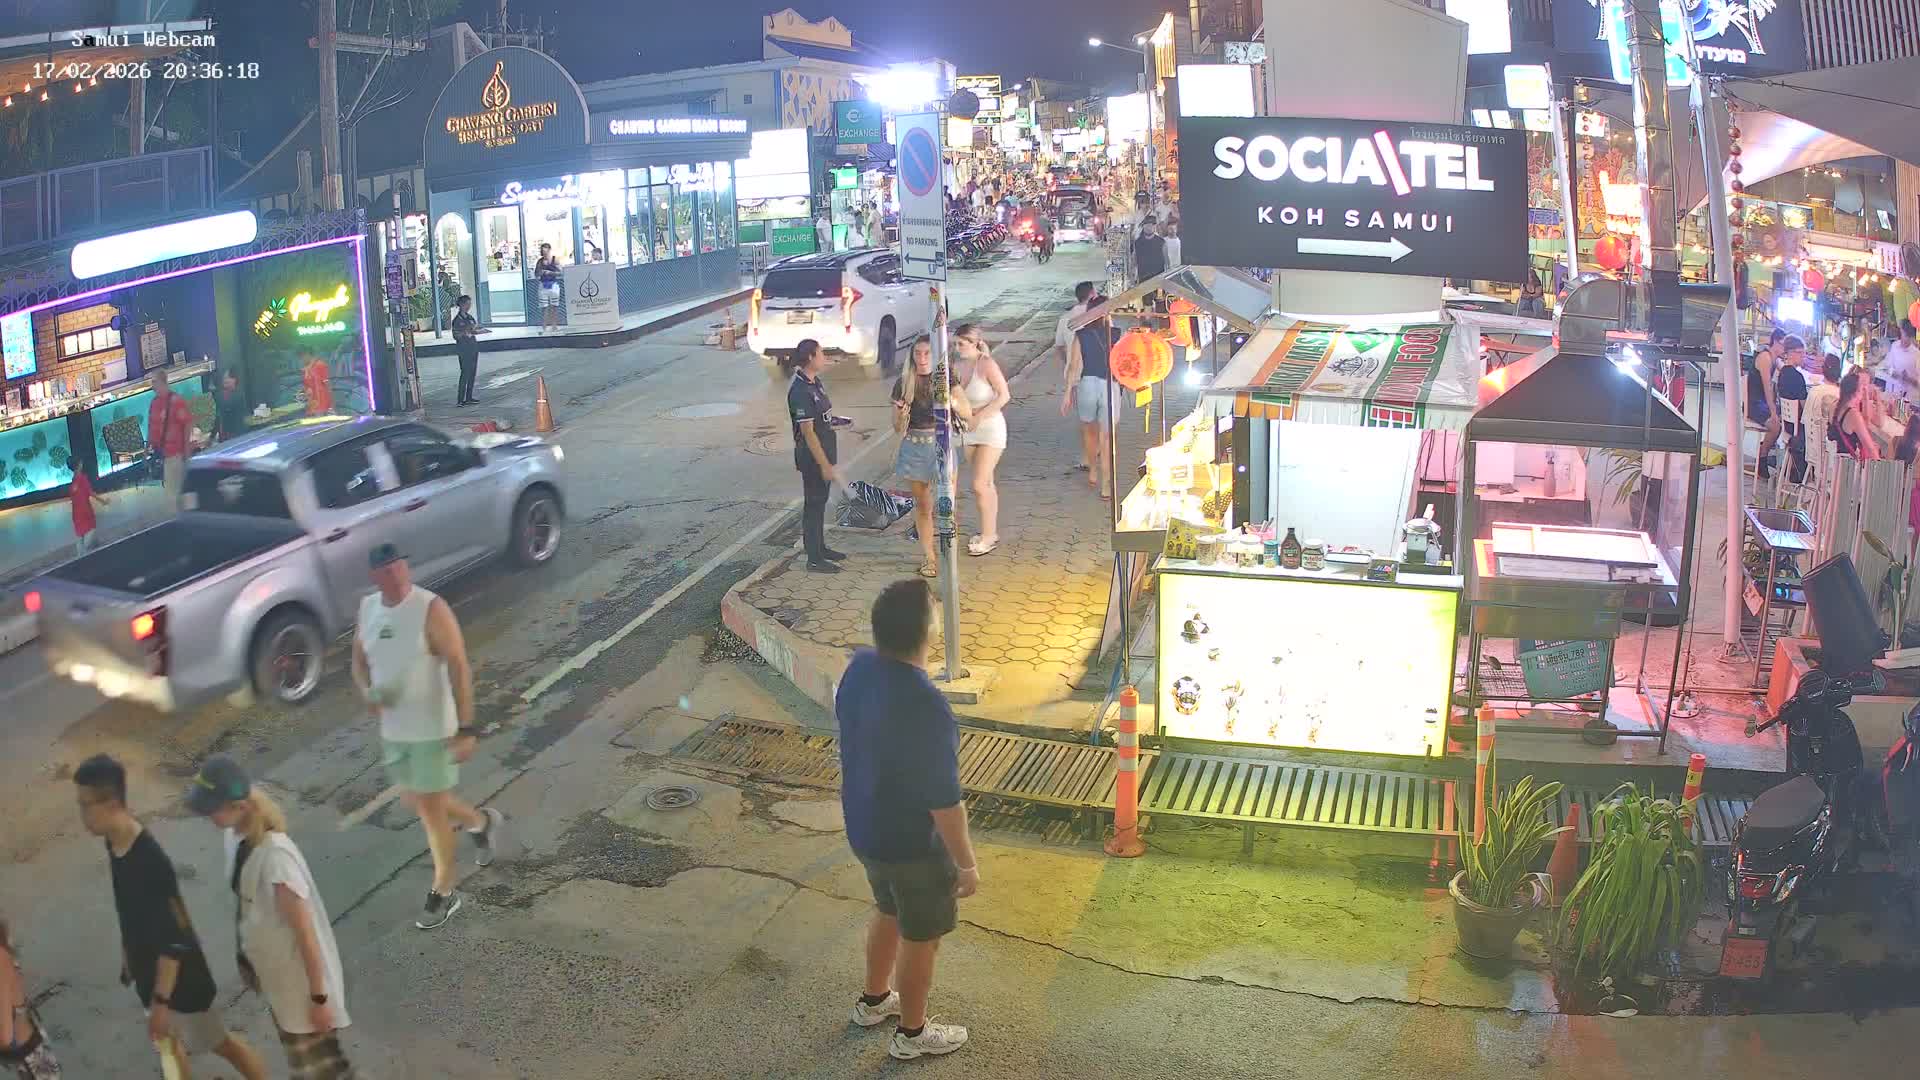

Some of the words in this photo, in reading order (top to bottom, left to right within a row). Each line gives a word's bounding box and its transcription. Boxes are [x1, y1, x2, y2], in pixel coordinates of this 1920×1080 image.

[839, 128, 879, 138] EXCHANGE
[1258, 206, 1324, 226] KOH
[1345, 208, 1453, 233] SAMUI
[773, 233, 811, 244] EXCHANGE
[906, 236, 914, 246] NO
[915, 238, 939, 247] PARKING
[1394, 327, 1443, 363] FOOD
[1571, 648, 1585, 659] 789
